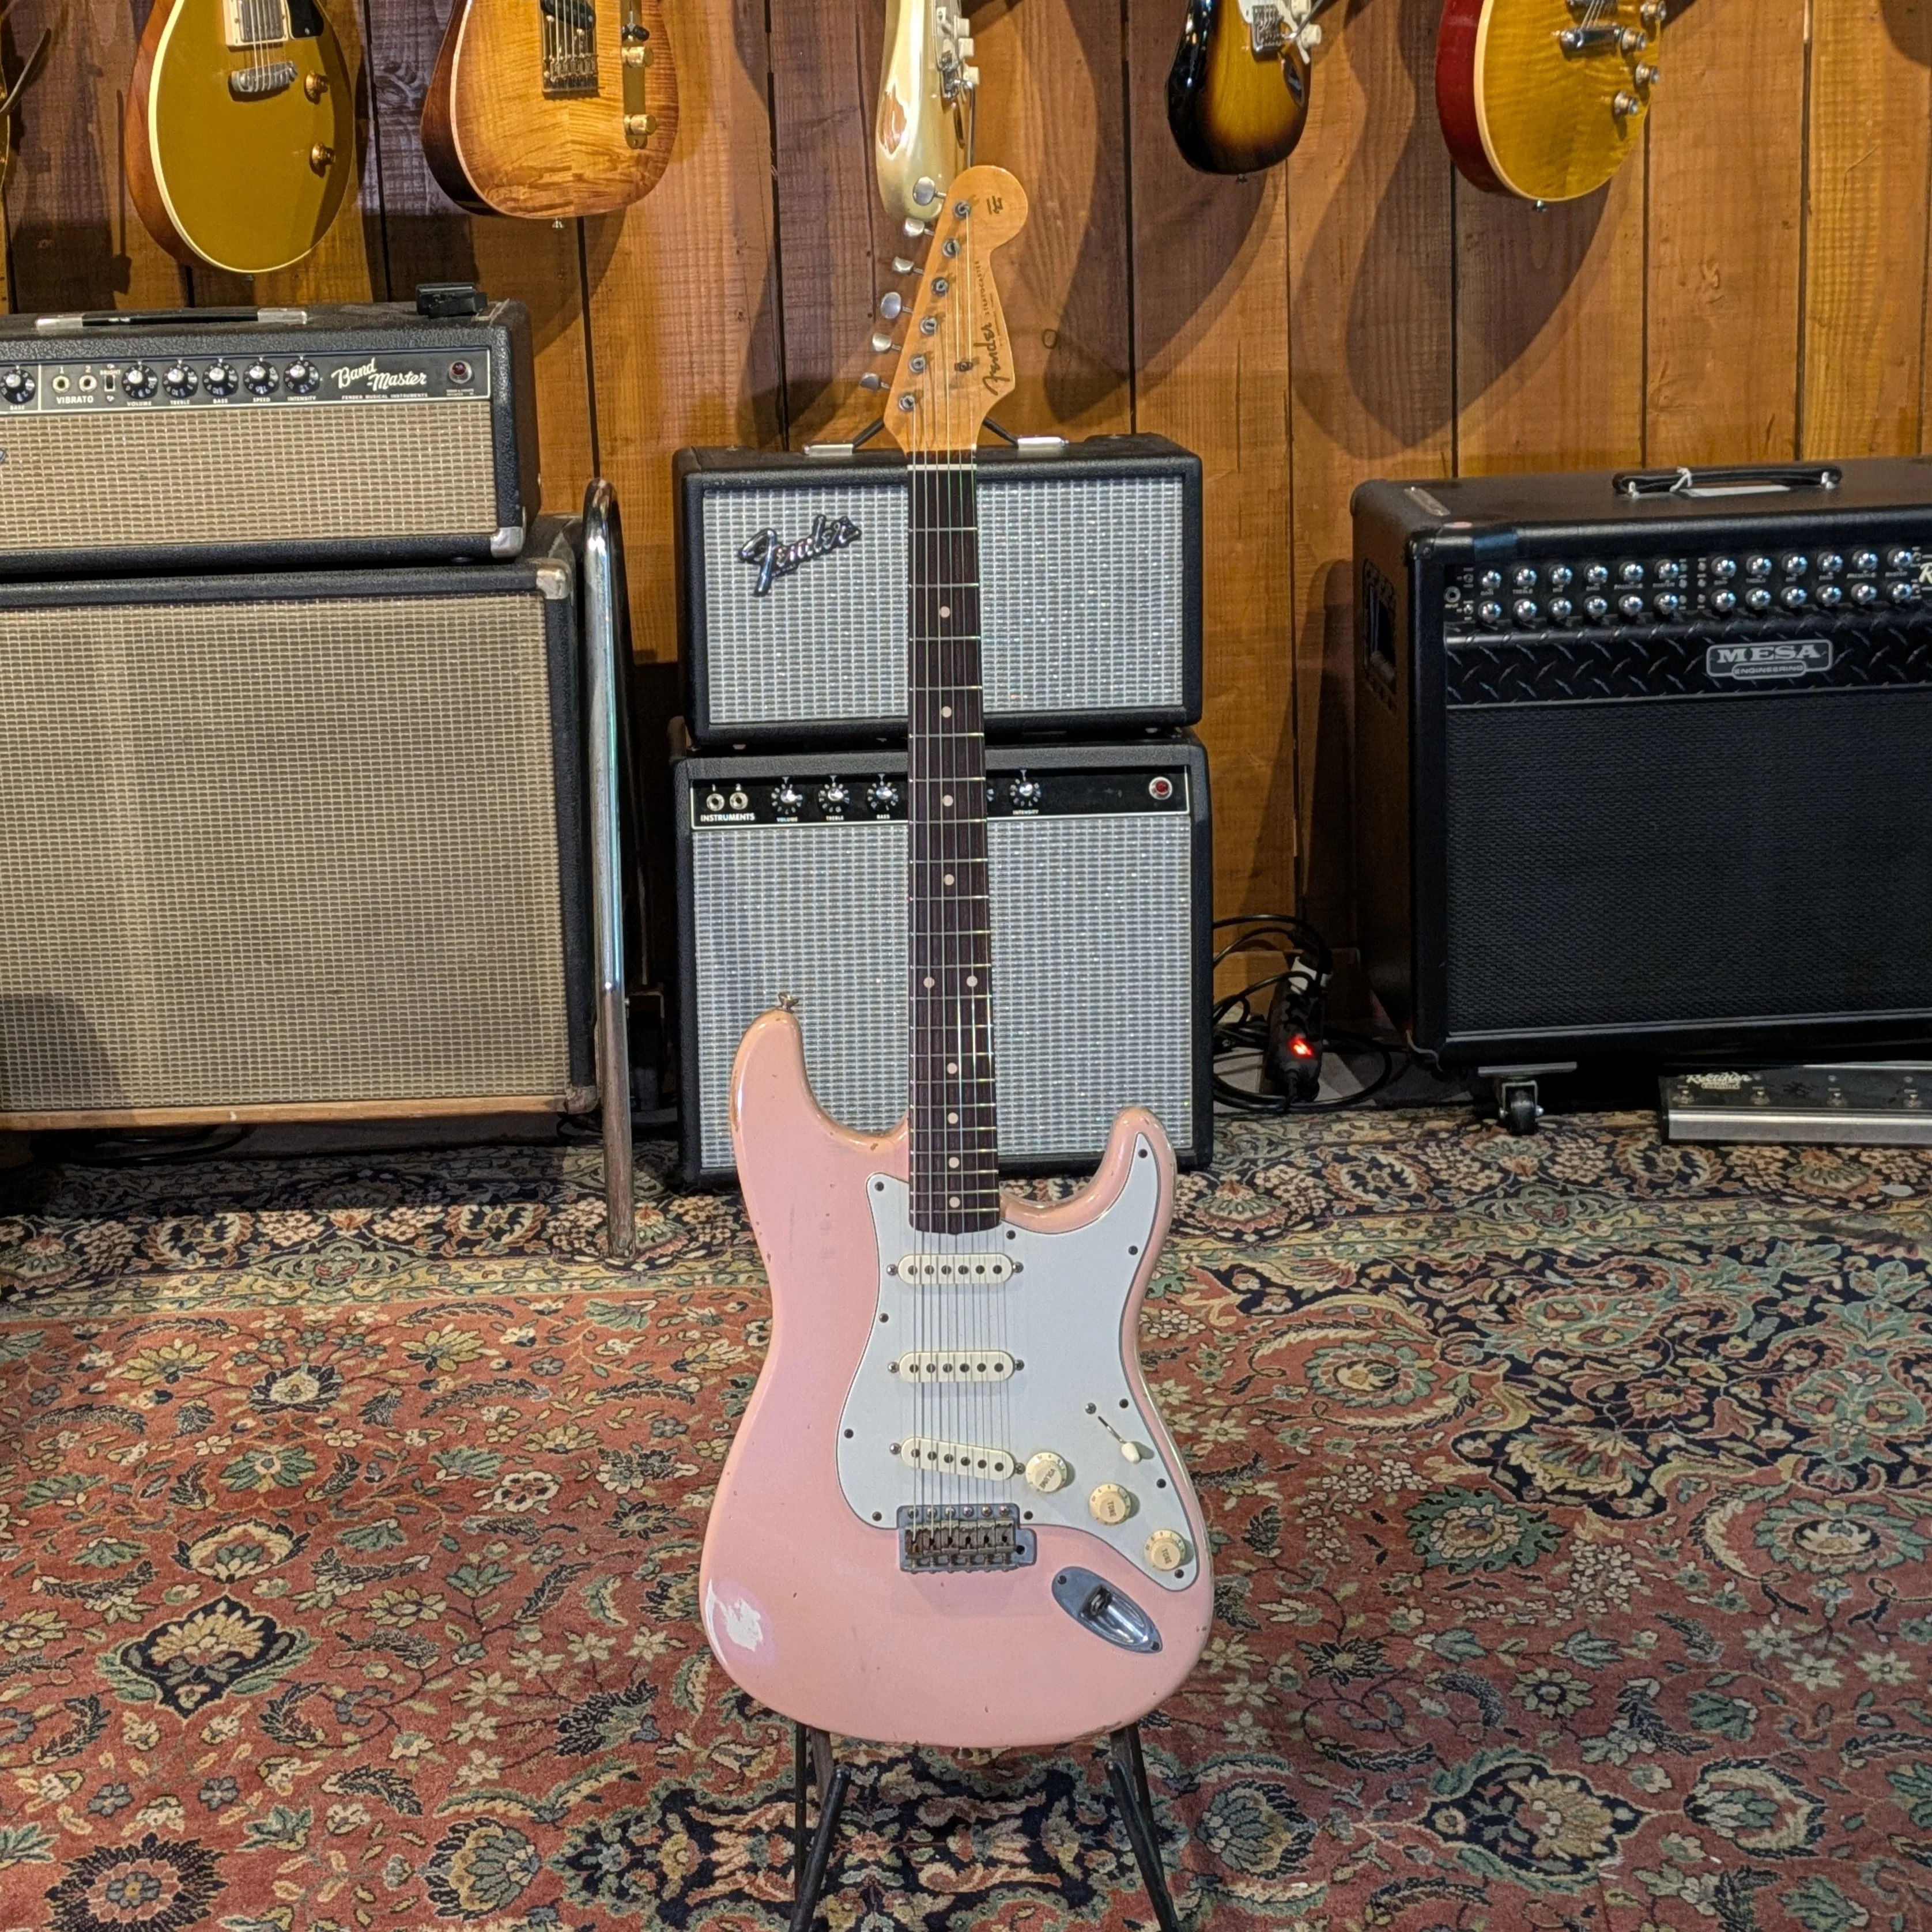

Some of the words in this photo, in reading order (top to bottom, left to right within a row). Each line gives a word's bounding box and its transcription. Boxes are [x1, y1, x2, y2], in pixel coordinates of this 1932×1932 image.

[973, 322, 1010, 396] Fender
[59, 366, 65, 374] 1
[85, 364, 92, 373] 2
[331, 357, 378, 389] Band
[56, 395, 94, 404] VIBRATO
[738, 514, 862, 597] Fender
[1716, 644, 1822, 663] MESA
[1734, 665, 1804, 675] ENGINEERING
[700, 812, 756, 822] INSTRUMENTS
[1039, 1468, 1056, 1489] VOLUME
[1107, 1500, 1117, 1518] TONE
[1161, 1547, 1172, 1565] TONE
